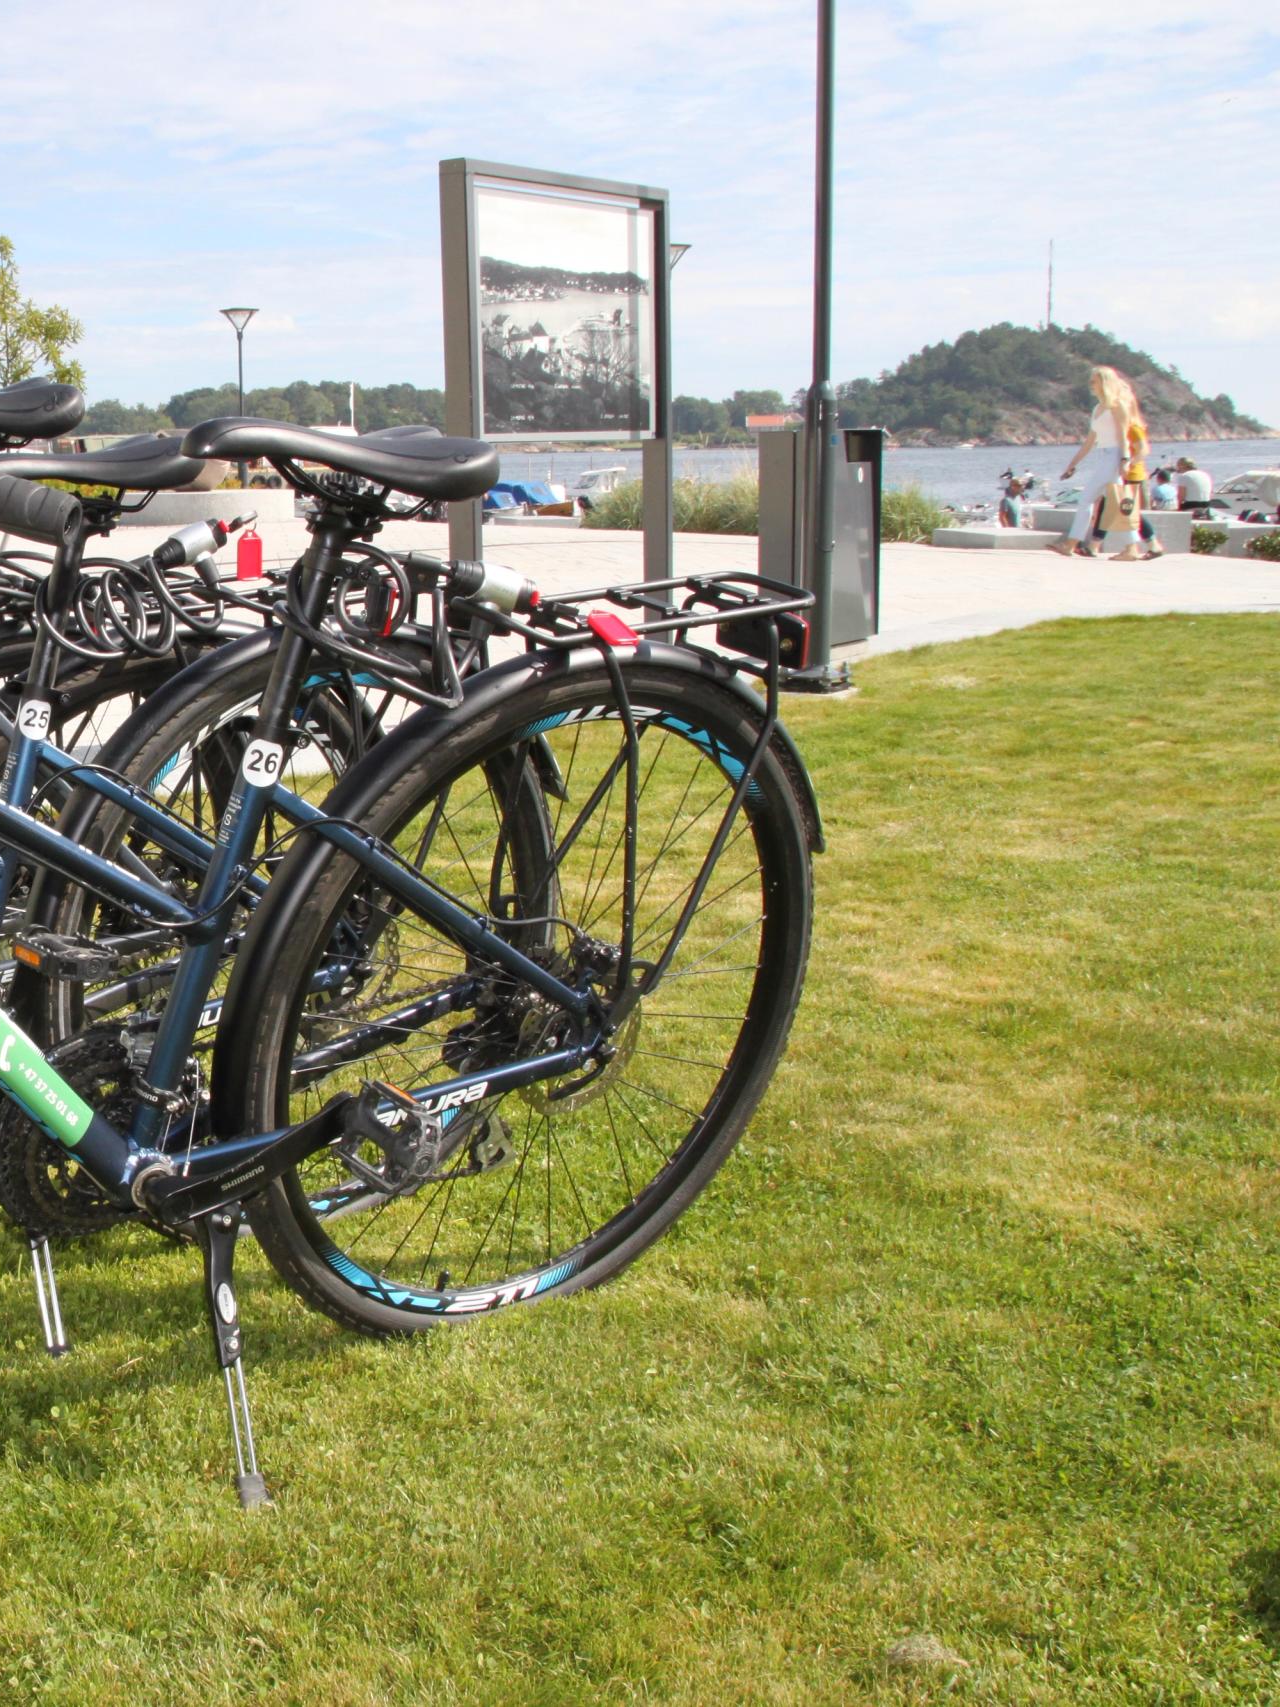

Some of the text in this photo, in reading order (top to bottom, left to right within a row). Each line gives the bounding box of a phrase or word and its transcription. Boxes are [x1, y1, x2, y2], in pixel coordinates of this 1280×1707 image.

[24, 708, 49, 728] 25
[247, 749, 279, 774] 26
[221, 1165, 266, 1192] SHIMANO
